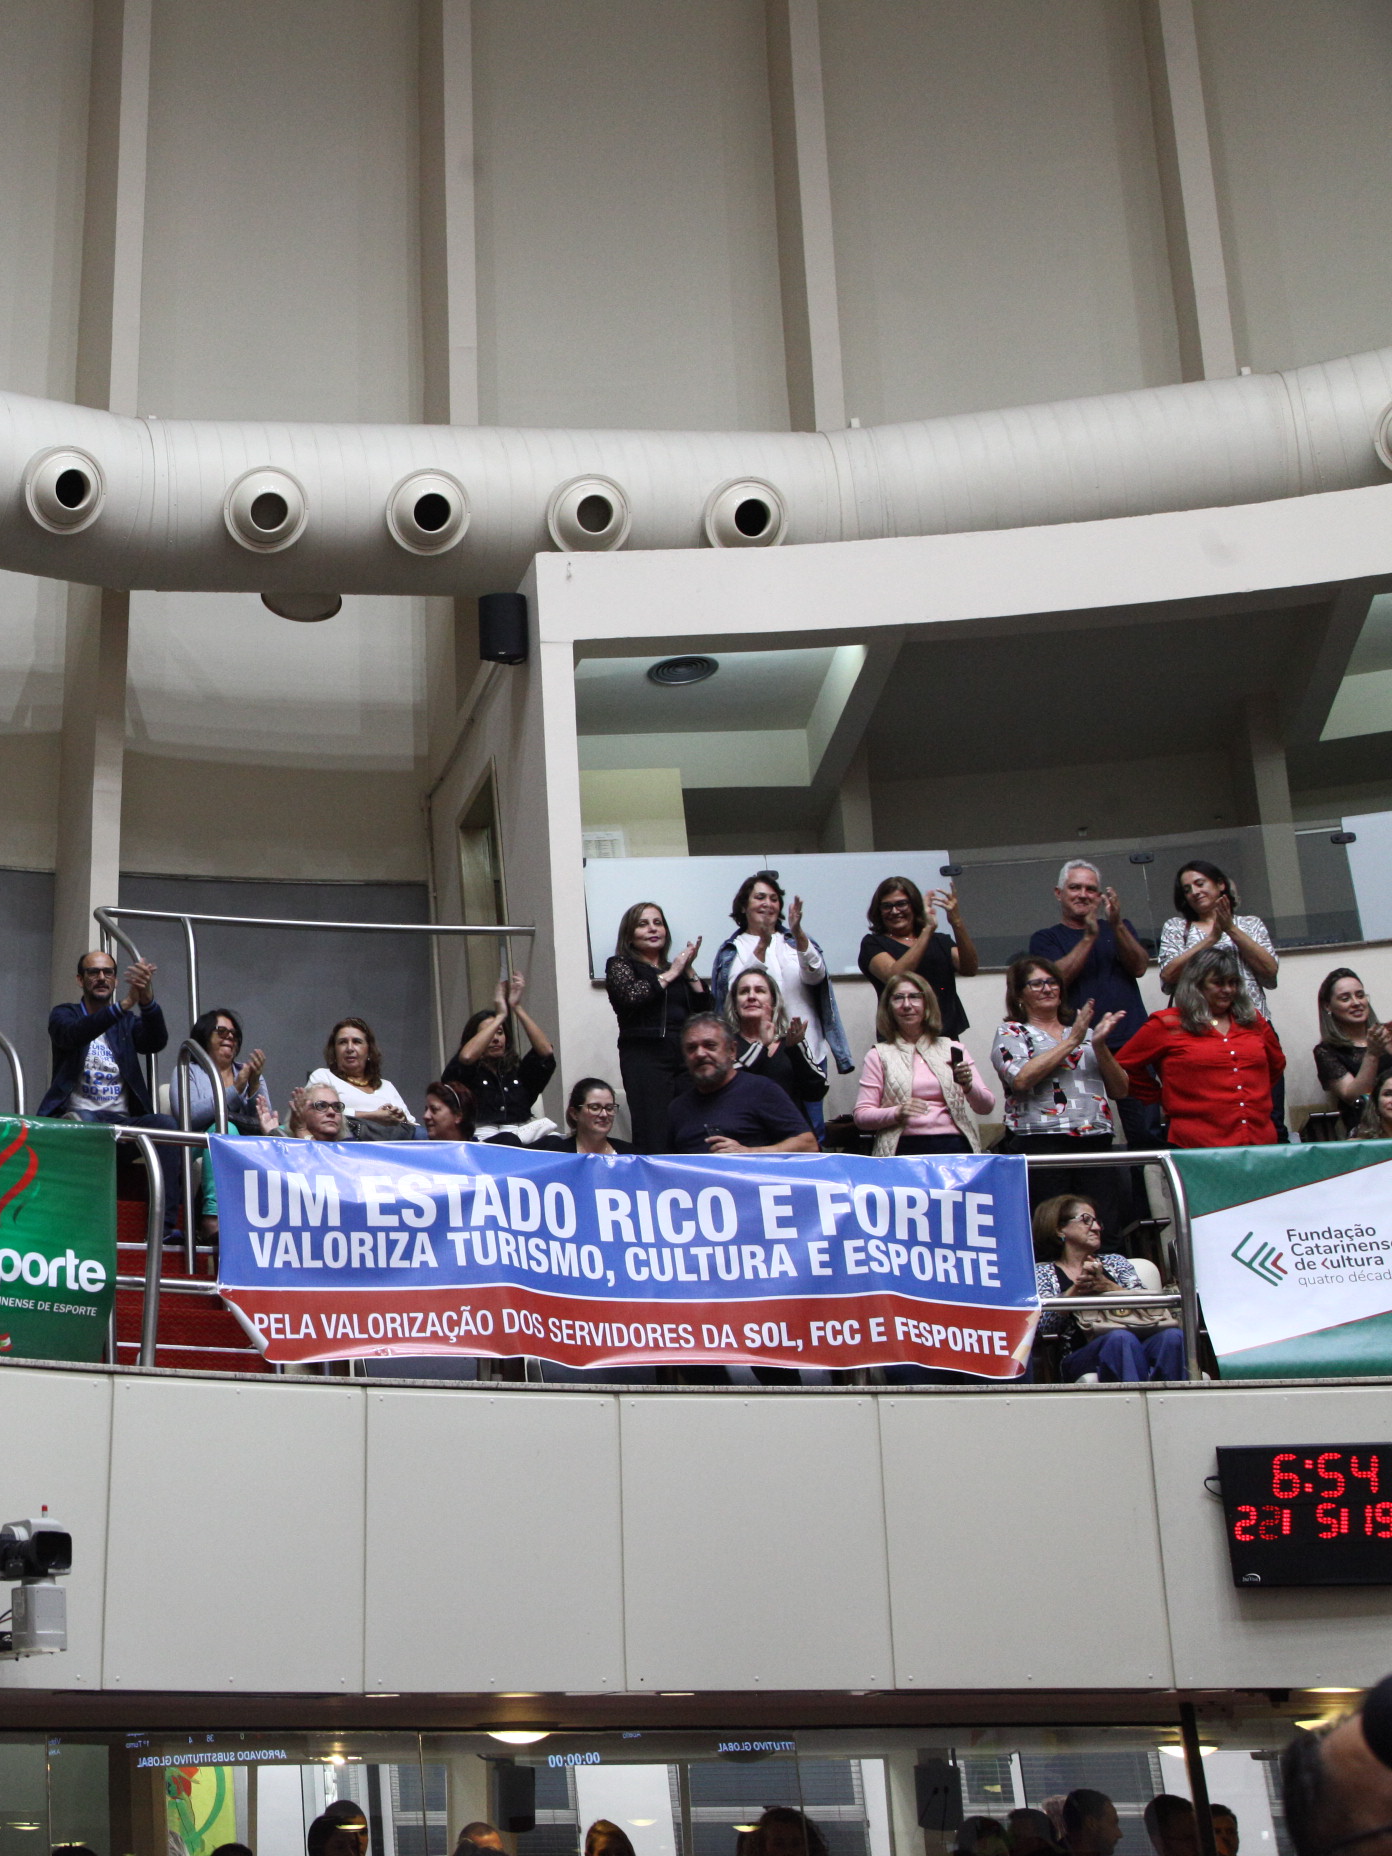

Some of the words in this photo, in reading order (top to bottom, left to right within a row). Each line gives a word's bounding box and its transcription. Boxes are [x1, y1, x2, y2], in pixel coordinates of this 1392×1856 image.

[102, 1085, 121, 1096] PIB
[244, 1169, 341, 1228] UM
[360, 1174, 577, 1239] ESTADO
[595, 1186, 739, 1243] RICO
[759, 1184, 798, 1240] E
[815, 1183, 997, 1249] FORTE
[1286, 1223, 1376, 1242] Fundação
[1290, 1239, 1392, 1256] Catarinens
[248, 1231, 439, 1269] VALORIZA
[447, 1230, 616, 1288] TURISMO,
[624, 1243, 798, 1282] CULTURA
[807, 1240, 833, 1276] E
[843, 1239, 1001, 1288] ESPORTE
[1294, 1257, 1317, 1271] de
[1298, 1273, 1344, 1288] quatro
[1348, 1268, 1392, 1282] décad
[37, 1301, 52, 1312] DE
[53, 1302, 98, 1317] ESPORTE
[253, 1312, 317, 1340] PELA
[321, 1306, 494, 1343] VALORIZAÇÃO
[502, 1308, 545, 1338] DOS
[549, 1317, 695, 1349] SERVIDORES
[702, 1323, 738, 1348] DA
[744, 1321, 804, 1351] SOL,
[810, 1319, 861, 1346] FCC
[870, 1317, 887, 1342] E
[894, 1315, 1010, 1356] FESPORTE
[1272, 1452, 1380, 1499] 6:54
